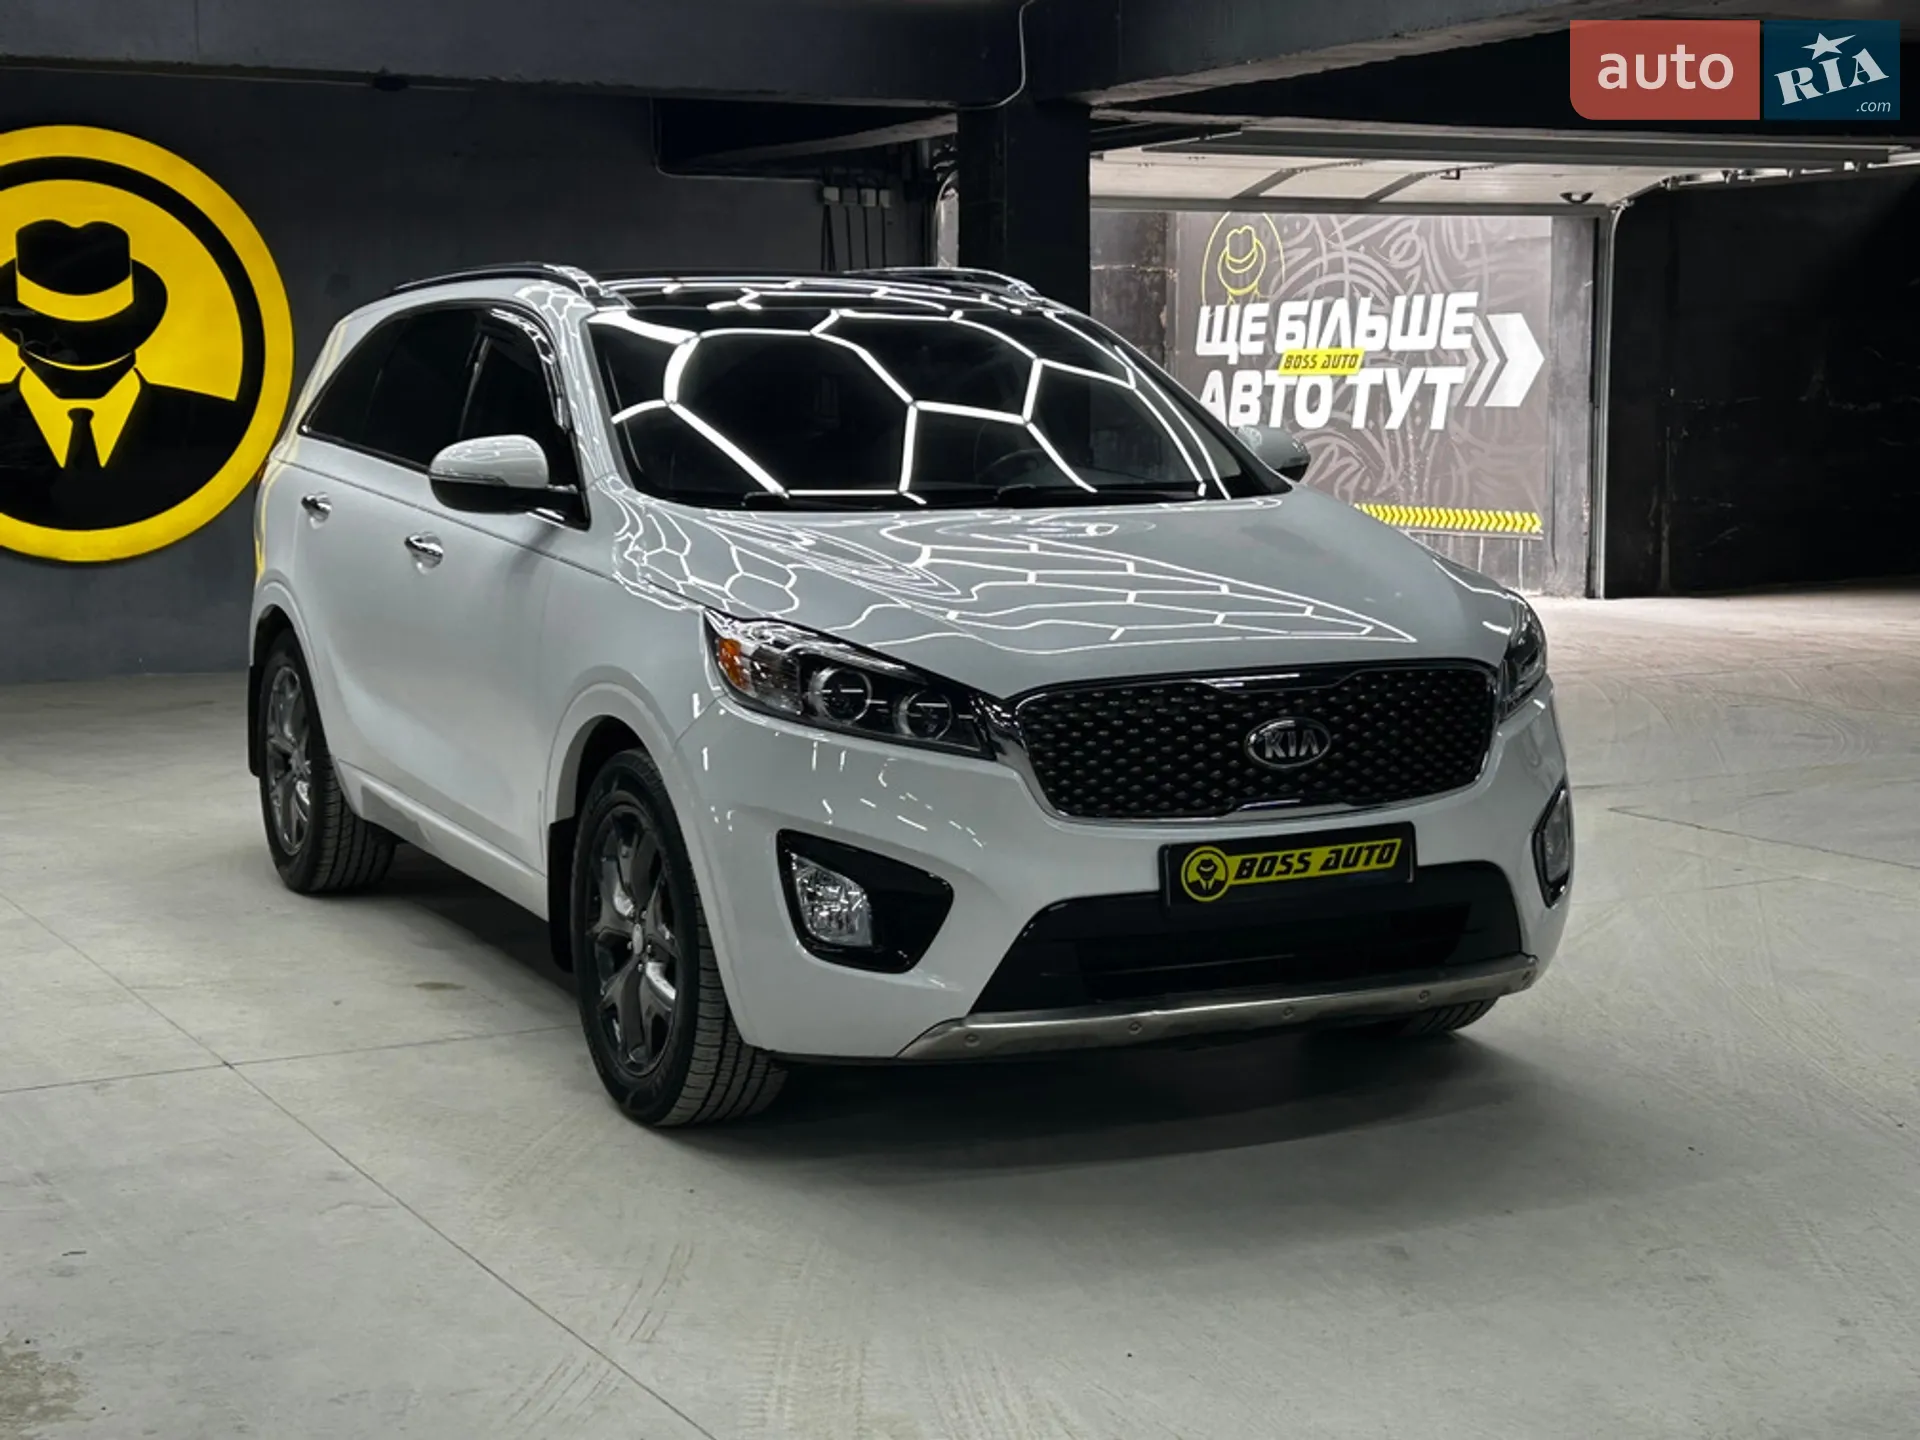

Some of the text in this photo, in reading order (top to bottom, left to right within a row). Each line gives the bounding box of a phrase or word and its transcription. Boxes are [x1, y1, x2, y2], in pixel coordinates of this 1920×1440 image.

[1195, 291, 1479, 364] ЩЕ БІЛЬШЕ
[1284, 353, 1359, 370] BOSS AUTO
[1200, 366, 1467, 430] АВТО ТУТ
[1265, 729, 1319, 759] KIA
[1233, 843, 1397, 880] BOSS AUTO
